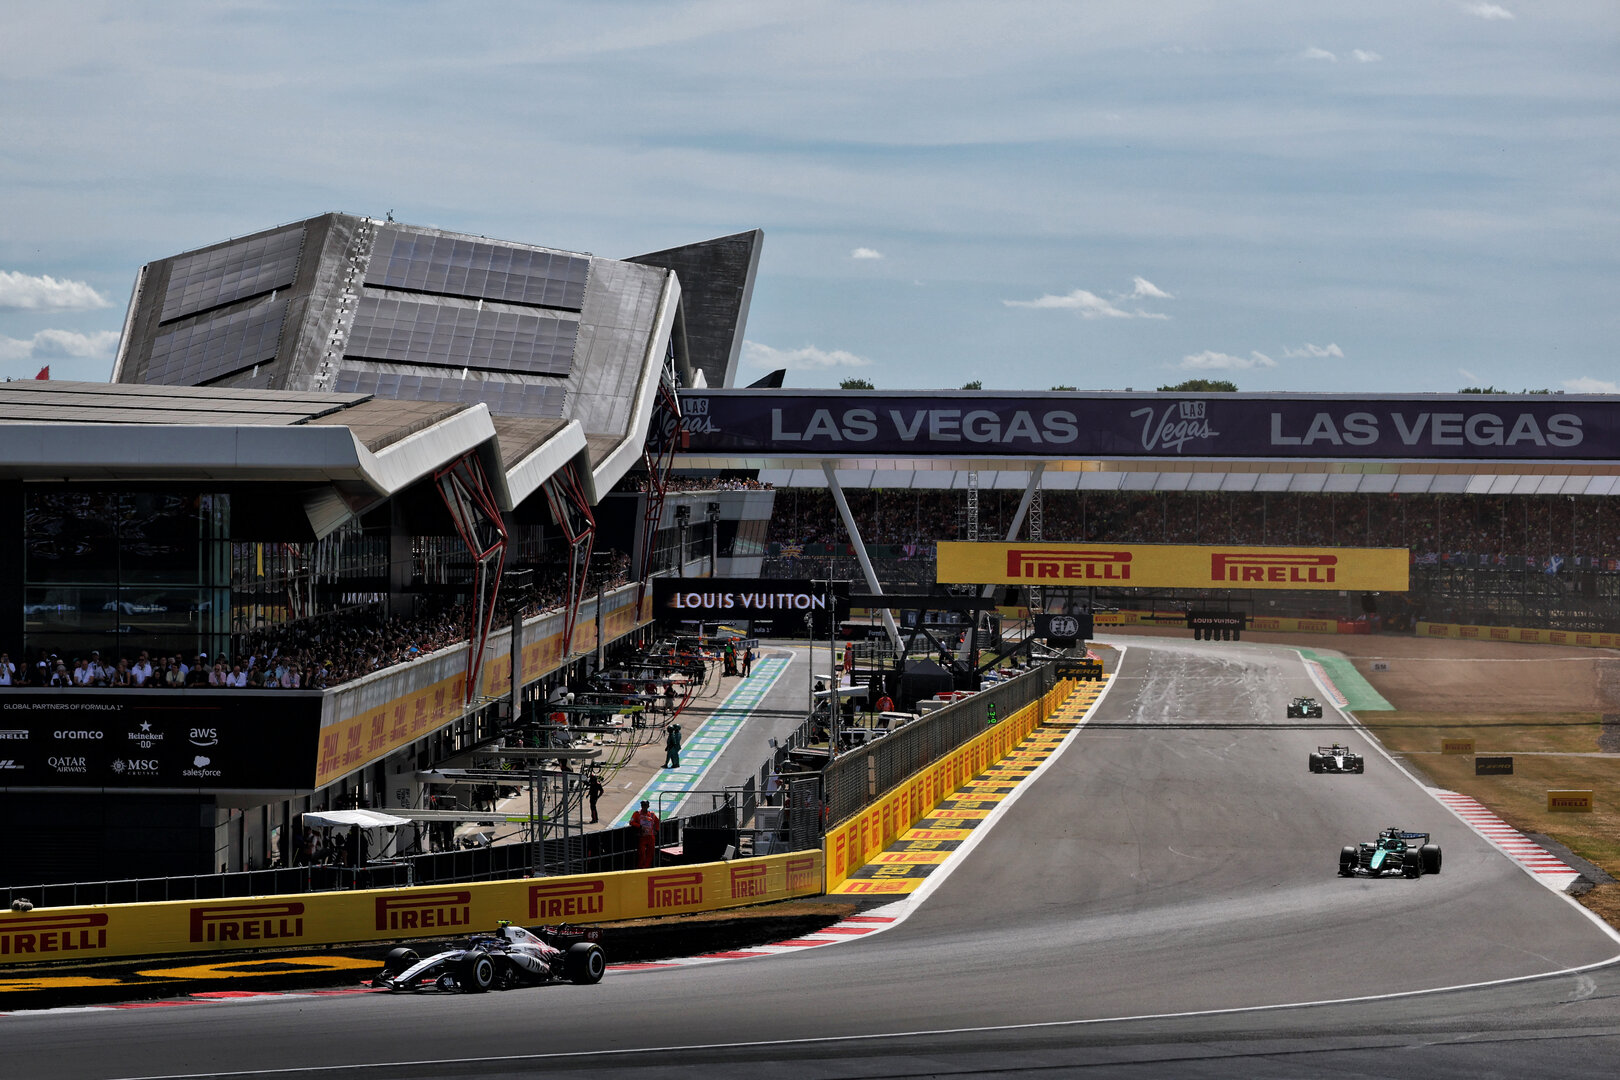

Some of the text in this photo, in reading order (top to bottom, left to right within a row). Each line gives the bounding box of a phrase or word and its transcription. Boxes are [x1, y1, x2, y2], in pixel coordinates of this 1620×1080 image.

[684, 400, 706, 413] LAS
[1182, 403, 1204, 417] LAS
[771, 408, 1079, 445] LAS VEGAS
[1130, 404, 1220, 454] Vegas
[1270, 412, 1584, 447] LAS VEGAS
[1007, 549, 1133, 580] PIRELLI
[1211, 553, 1338, 583] PIRELLI
[675, 592, 826, 610] LOUIS VUITTON
[0, 730, 29, 740] RELLI
[53, 730, 104, 739] aramco
[128, 732, 164, 740] Heineken
[189, 727, 217, 738] aws
[47, 756, 86, 768] QATAR
[127, 759, 159, 771] MSC
[182, 768, 221, 778] salesforce
[730, 864, 767, 899] PIRELLI
[785, 857, 814, 891] PIRELLI
[528, 880, 605, 919] PIRELLI
[647, 872, 703, 908] PIRELLI
[189, 902, 305, 943] PIRELLI
[375, 891, 471, 931] PIRELLI
